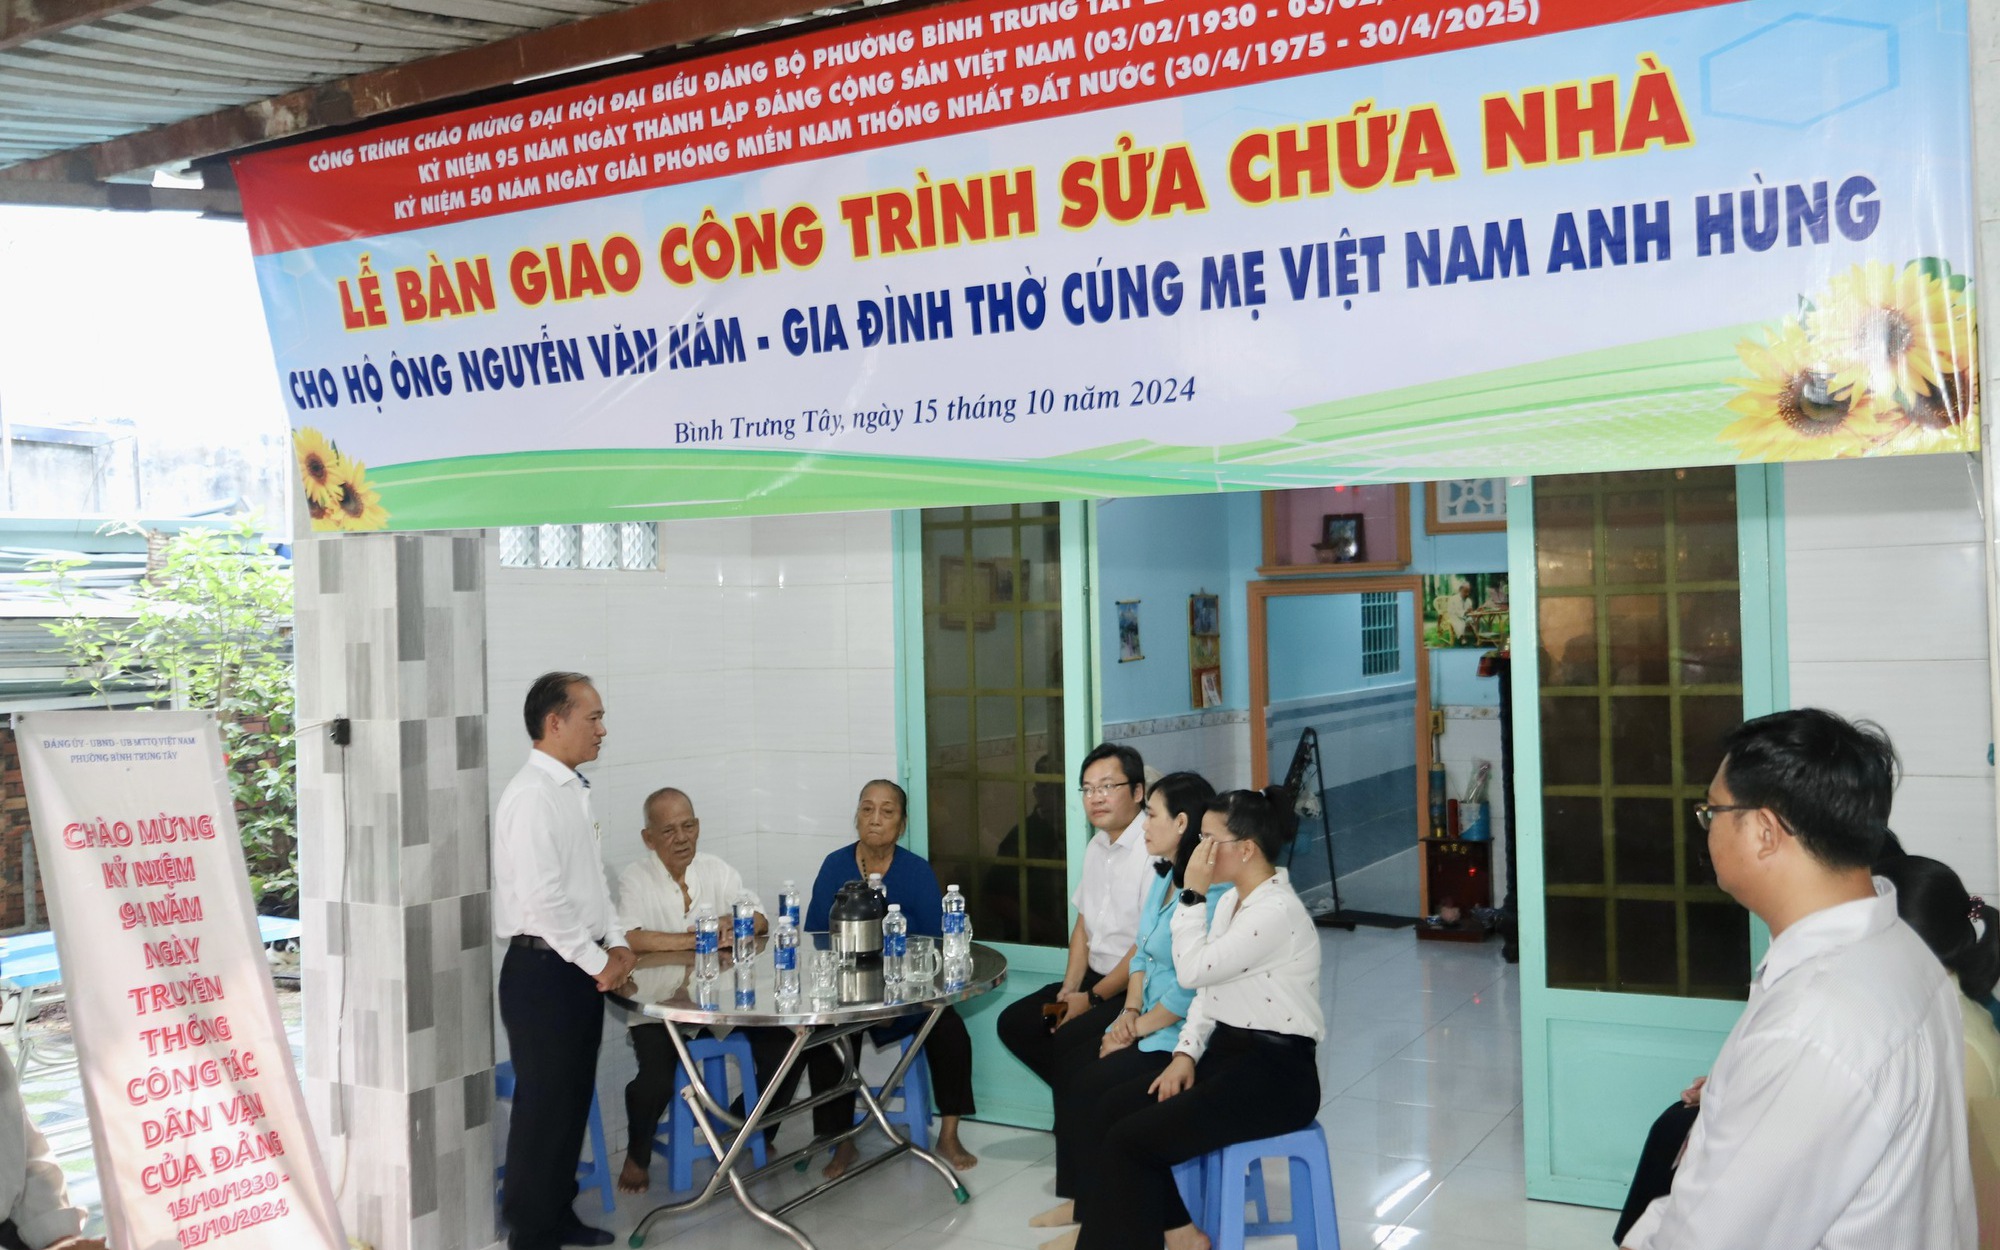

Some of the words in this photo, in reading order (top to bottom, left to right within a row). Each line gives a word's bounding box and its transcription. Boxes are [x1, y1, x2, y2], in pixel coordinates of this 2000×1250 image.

[308, 148, 355, 173] CÔNG
[358, 137, 410, 163] TRÌNH
[414, 126, 462, 152] CHÀO
[467, 113, 524, 142] MỪNG
[528, 105, 563, 130] ĐẠI
[568, 95, 605, 122] HỘI
[609, 87, 646, 113] ĐẠI
[652, 75, 698, 104] BIỂU
[703, 60, 768, 93] ĐẢNG
[774, 49, 807, 78] BỘ
[812, 29, 915, 70] PHƯỜNG
[921, 15, 983, 48] BÌNH
[989, 0, 1079, 34] TRƯNG
[393, 194, 416, 220] KỶ
[420, 189, 466, 216] NIỆM
[470, 185, 493, 207] 50
[497, 176, 542, 202] NĂM
[545, 164, 599, 193] NGÀY
[604, 152, 648, 182] GIẢI
[653, 141, 730, 174] PHÓNG
[736, 125, 793, 159] MIỀN
[799, 117, 853, 147] NAM
[857, 100, 941, 136] THỐNG
[947, 83, 1014, 120] NHẤT
[1020, 72, 1071, 107] ĐẤT
[1079, 60, 1156, 97] NƯỚC
[1164, 31, 1327, 88] (30/4/1975
[1336, 38, 1349, 48] -
[1359, 0, 1540, 49] 30/4/2025)
[418, 157, 441, 184] KỶ
[445, 152, 492, 179] NIỆM
[495, 146, 519, 169] 95
[523, 137, 569, 163] NĂM
[573, 124, 628, 154] NGÀY
[632, 109, 704, 142] THÀNH
[710, 100, 749, 127] LẬP
[754, 86, 822, 119] ĐẢNG
[828, 71, 895, 107] CỘNG
[900, 59, 949, 91] SẢN
[953, 48, 1008, 79] VIỆT
[1015, 36, 1077, 69] NAM
[1084, 2, 1257, 62] (03/02/1930
[1266, 8, 1278, 18] -
[338, 253, 388, 329] LỄ
[396, 252, 496, 321] BÀN
[510, 236, 641, 305] GIAO
[660, 206, 823, 284] CÔNG
[841, 170, 1035, 257] TRÌNH
[1062, 136, 1205, 227] SỬA
[1230, 102, 1457, 203] CHỮA
[1484, 57, 1690, 169] NHÀ
[290, 368, 339, 410] CHO
[343, 353, 384, 413] HỘ
[390, 350, 453, 400] ÔNG
[459, 325, 585, 393] NGUYỄN
[587, 323, 658, 378] VĂN
[669, 312, 747, 370] NĂM
[757, 335, 770, 350] -
[782, 303, 849, 357] GIA
[856, 285, 953, 348] ĐÌNH
[964, 265, 1047, 336] THỜ
[1062, 257, 1184, 326] CÚNG
[1201, 250, 1266, 320] MẸ
[1280, 227, 1387, 311] VIỆT
[1406, 218, 1530, 287] NAM
[1547, 200, 1671, 273] ANH
[1695, 173, 1882, 257] HÙNG
[675, 418, 723, 444] Bình
[730, 416, 796, 440] Trưng
[802, 408, 845, 433] Tây,
[853, 402, 904, 434] ngày
[913, 398, 938, 424] 15
[947, 393, 1017, 422] tháng
[1027, 388, 1055, 415] 10
[1063, 385, 1120, 412] năm
[1130, 376, 1196, 407] 2024
[90, 739, 115, 748] UBND
[134, 738, 159, 747] MTTQ
[159, 736, 176, 747] VIỆT
[178, 737, 195, 746] NAM
[162, 751, 177, 760] TÂY
[63, 817, 133, 850] CHÀO
[137, 813, 216, 845] MỪNG
[101, 855, 128, 889] KỶ
[132, 852, 196, 889] NIỆM
[119, 902, 147, 930] 94
[147, 893, 203, 927] NĂM
[143, 935, 200, 970] NGÀY
[128, 972, 224, 1016] TRUYỀN
[139, 1013, 232, 1057] THỐNG
[126, 1059, 221, 1106] CÔNG
[221, 1049, 259, 1082] TÁC
[142, 1106, 212, 1150] DÂN
[218, 1090, 265, 1126] VẬN
[140, 1152, 206, 1195] CỦA
[210, 1131, 285, 1174] ĐẢNG
[167, 1171, 279, 1221] 15/10/1930
[177, 1198, 290, 1249] 15/10/2024
